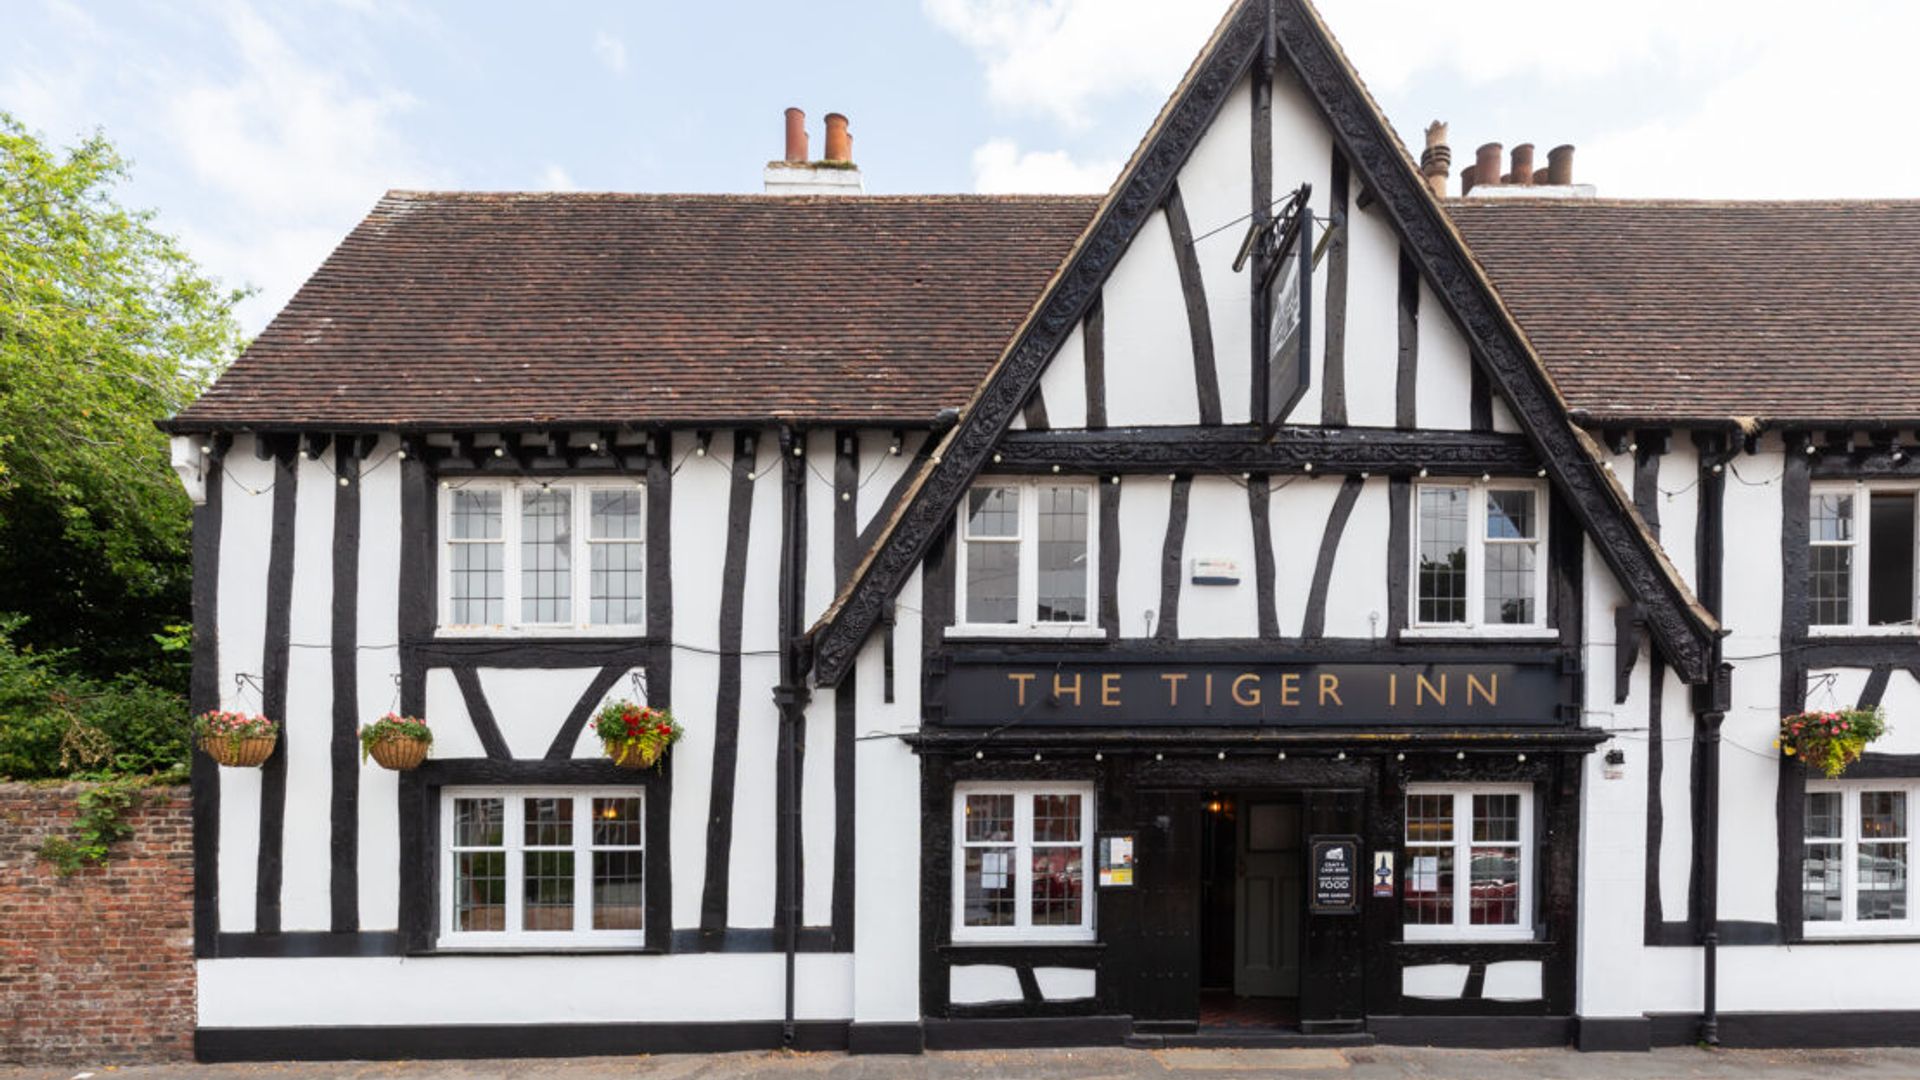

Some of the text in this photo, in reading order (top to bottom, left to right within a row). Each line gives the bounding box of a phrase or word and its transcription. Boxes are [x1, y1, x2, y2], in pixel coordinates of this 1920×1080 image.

[1008, 672, 1499, 706] THE TIGER INN
[1319, 881, 1349, 889] FOOD
